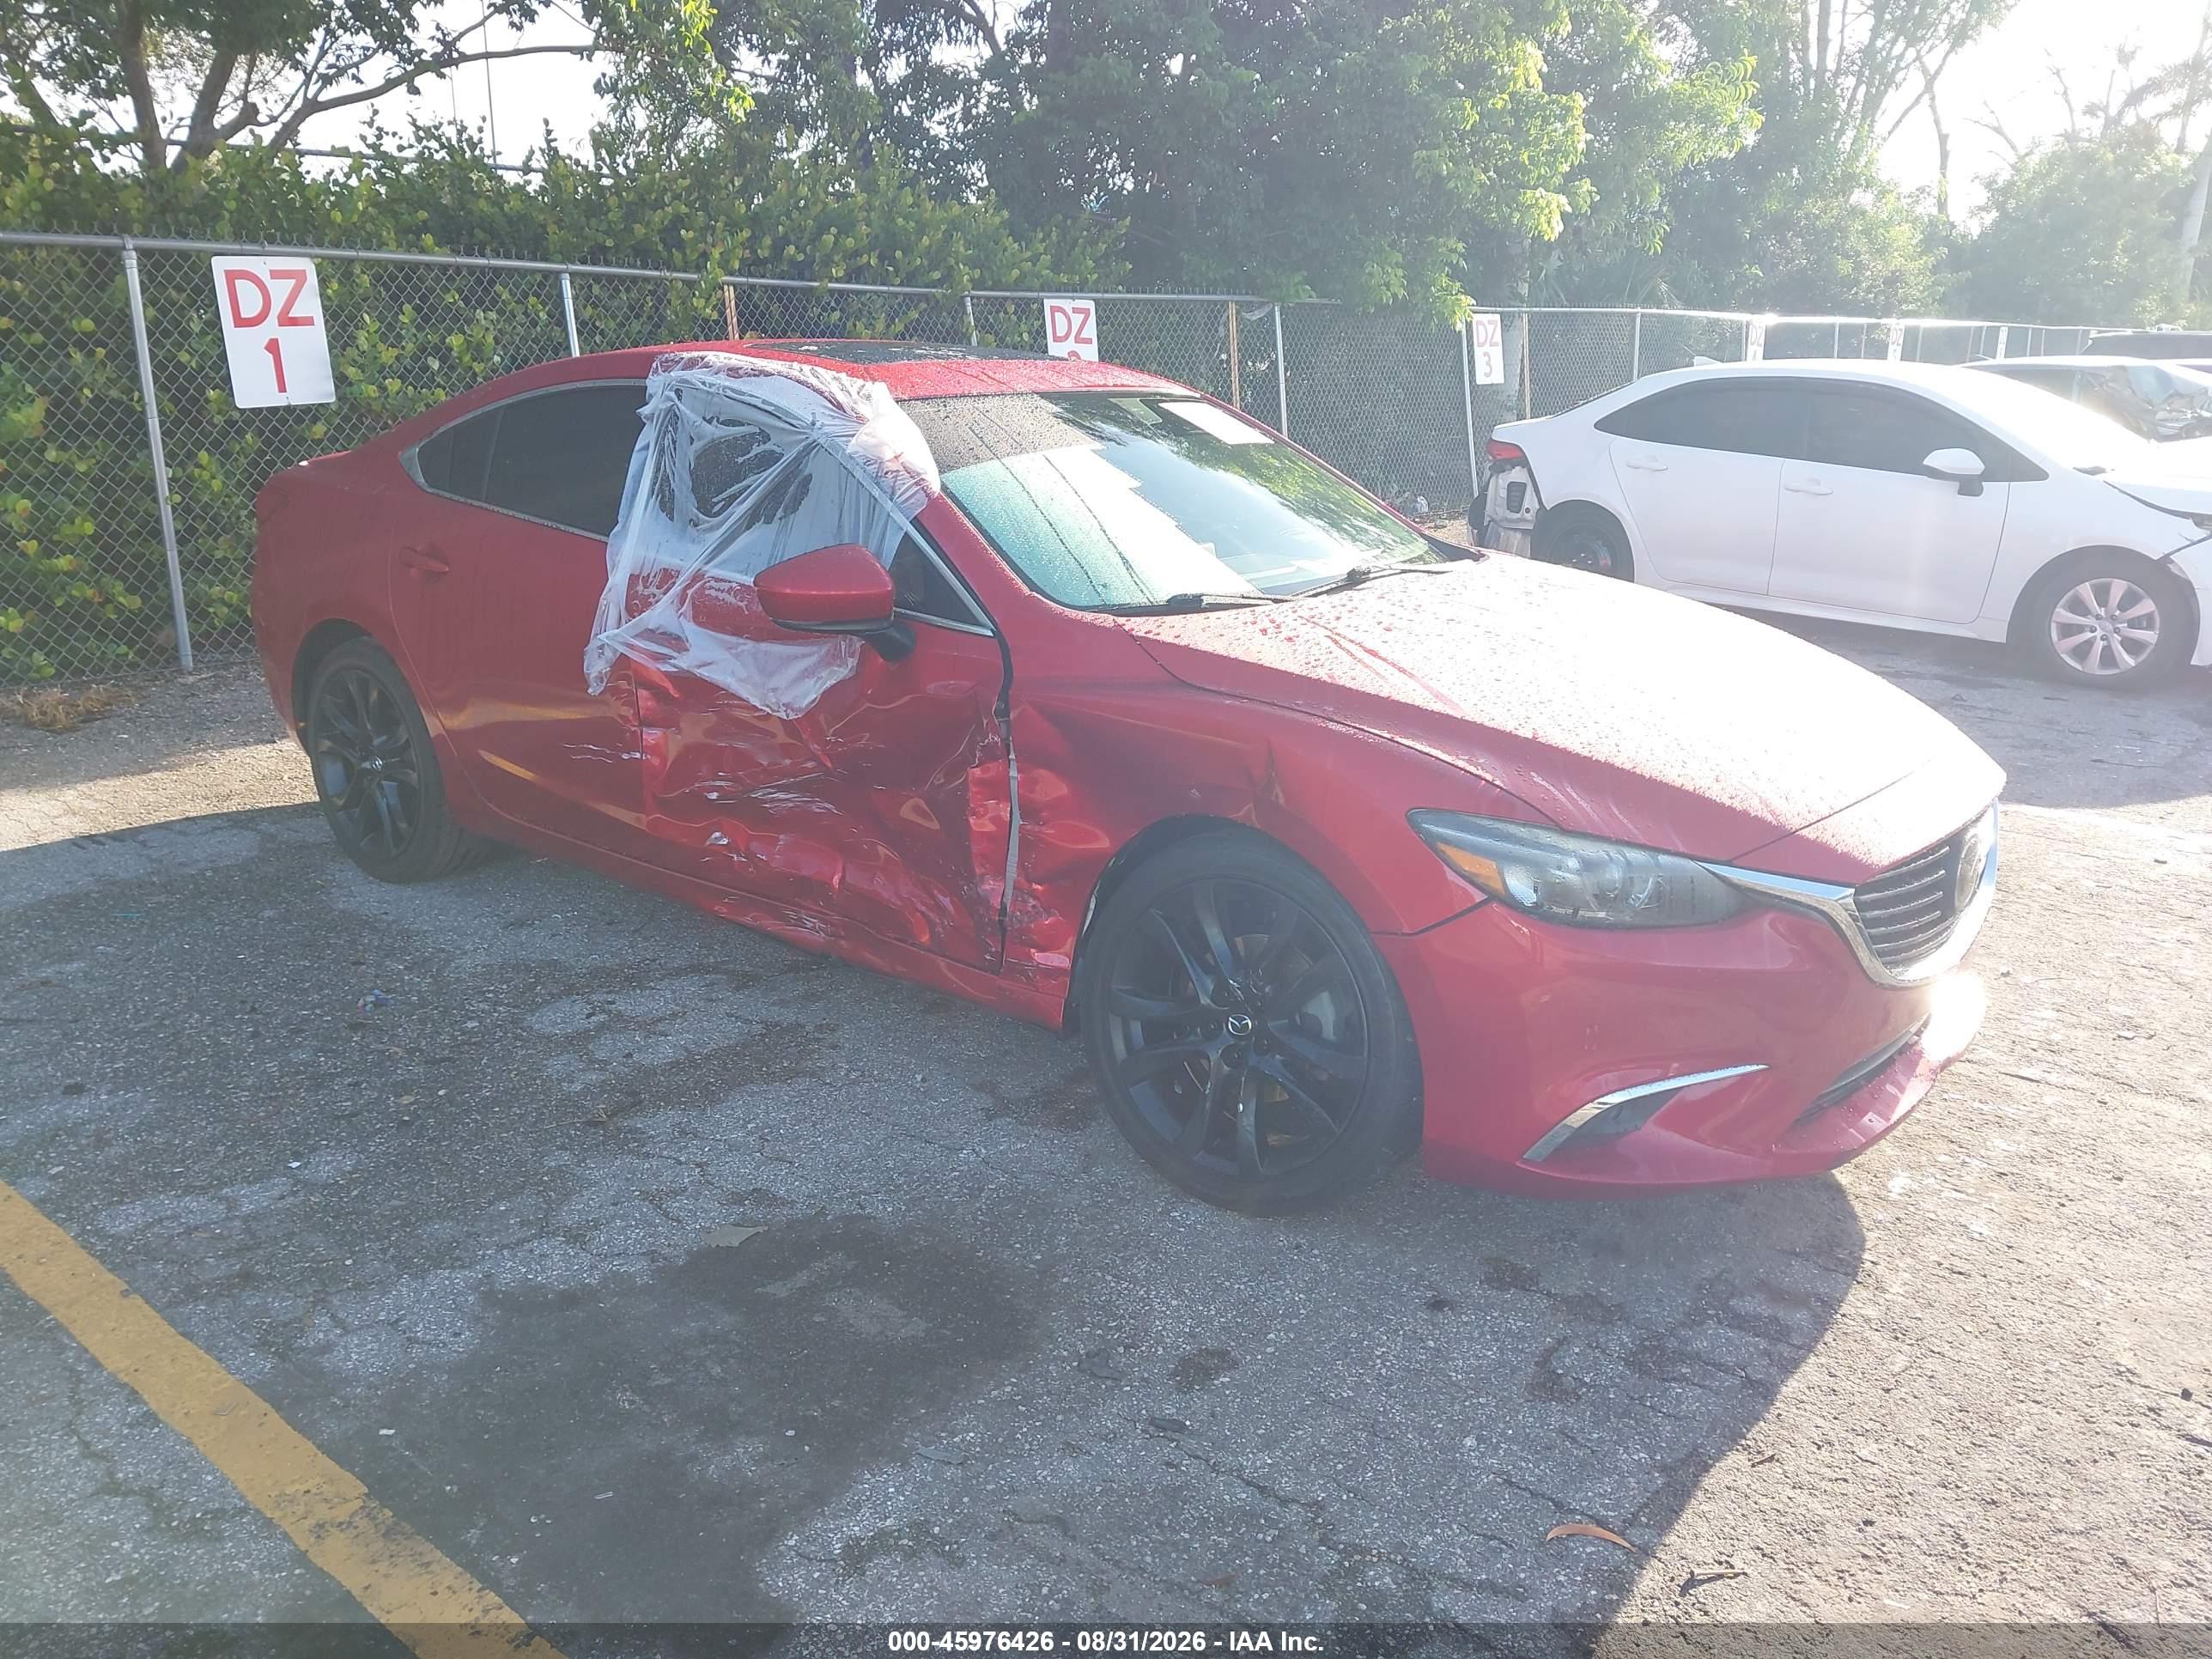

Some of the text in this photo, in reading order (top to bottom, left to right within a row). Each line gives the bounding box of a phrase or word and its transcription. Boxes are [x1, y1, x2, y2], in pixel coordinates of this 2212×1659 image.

[223, 269, 315, 328] DZ
[1050, 305, 1093, 344] DZ
[1476, 319, 1499, 347] DZ
[264, 337, 288, 393] 1
[1482, 351, 1492, 378] 3
